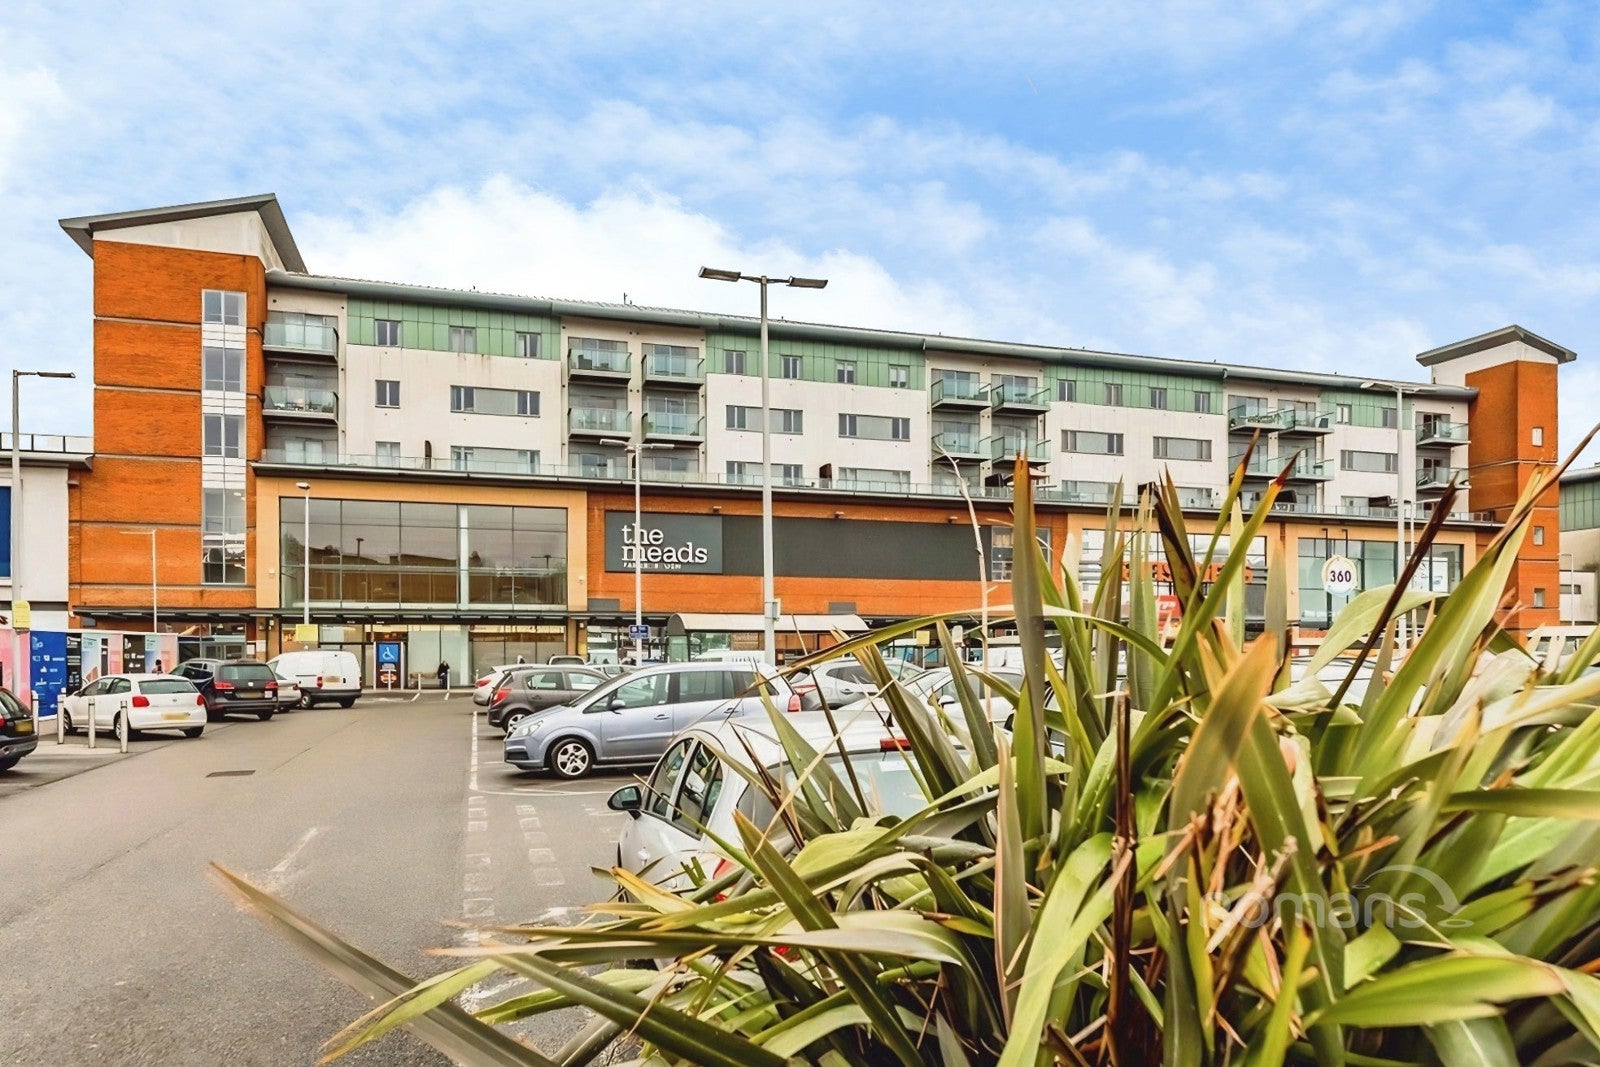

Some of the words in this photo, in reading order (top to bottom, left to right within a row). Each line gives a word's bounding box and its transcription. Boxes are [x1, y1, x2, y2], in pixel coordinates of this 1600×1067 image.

[621, 523, 664, 545] the
[621, 542, 708, 563] meads
[1330, 570, 1352, 583] 360
